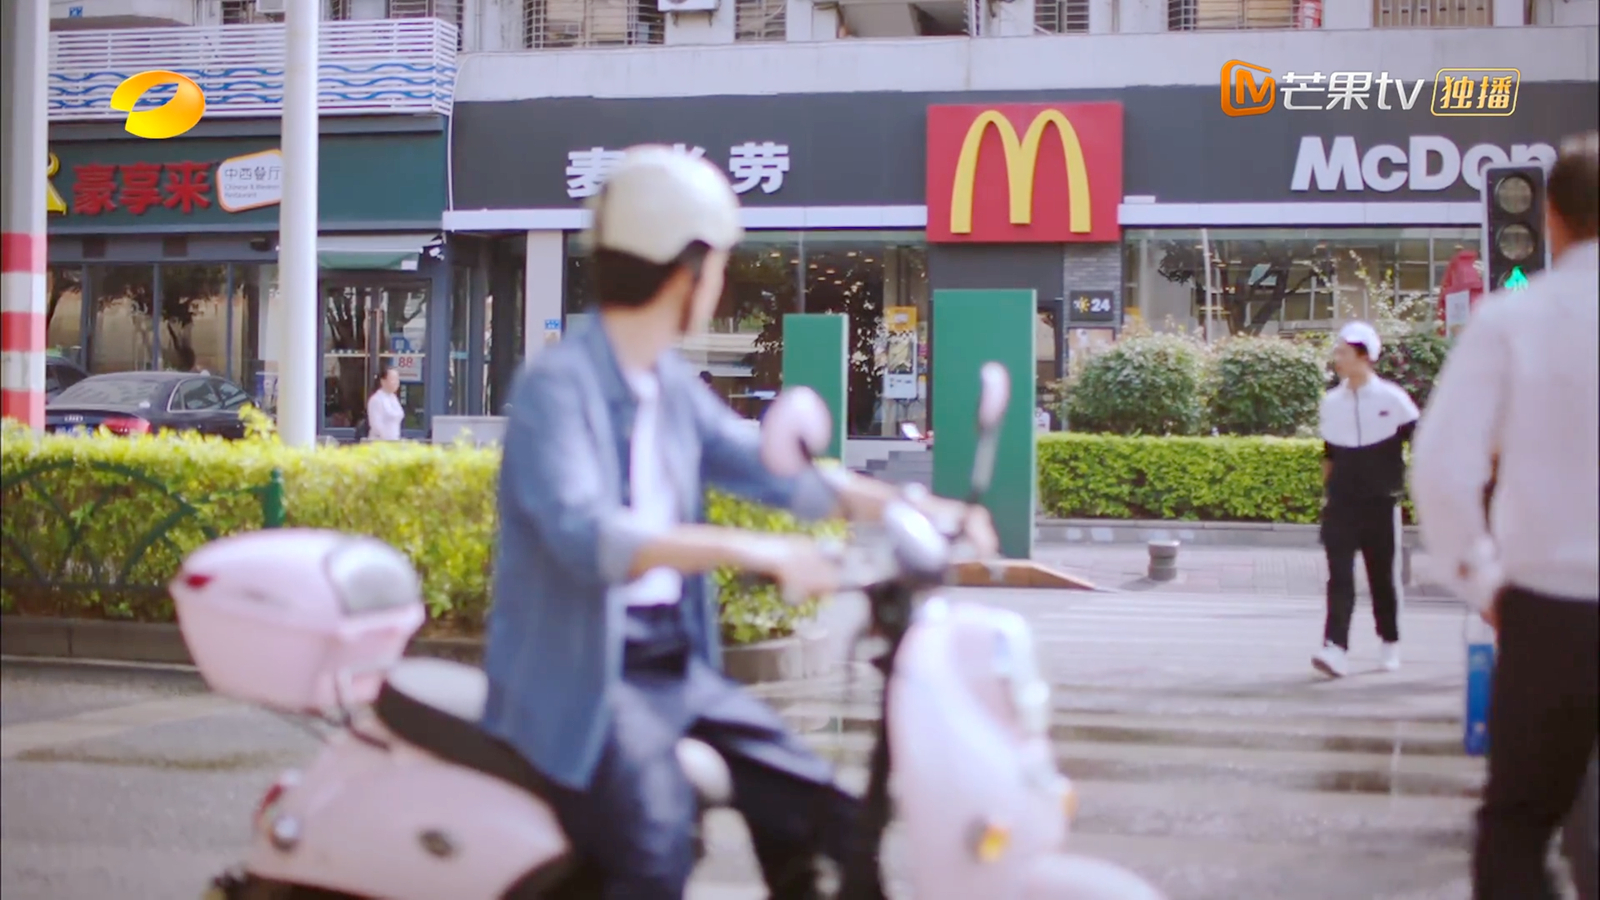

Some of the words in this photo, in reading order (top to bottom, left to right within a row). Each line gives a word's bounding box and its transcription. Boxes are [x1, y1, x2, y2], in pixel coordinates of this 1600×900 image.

[225, 166, 281, 181] 中西餐厅
[566, 141, 790, 198] 麦劳
[73, 160, 212, 216] 豪享来
[1091, 297, 1111, 312] 24
